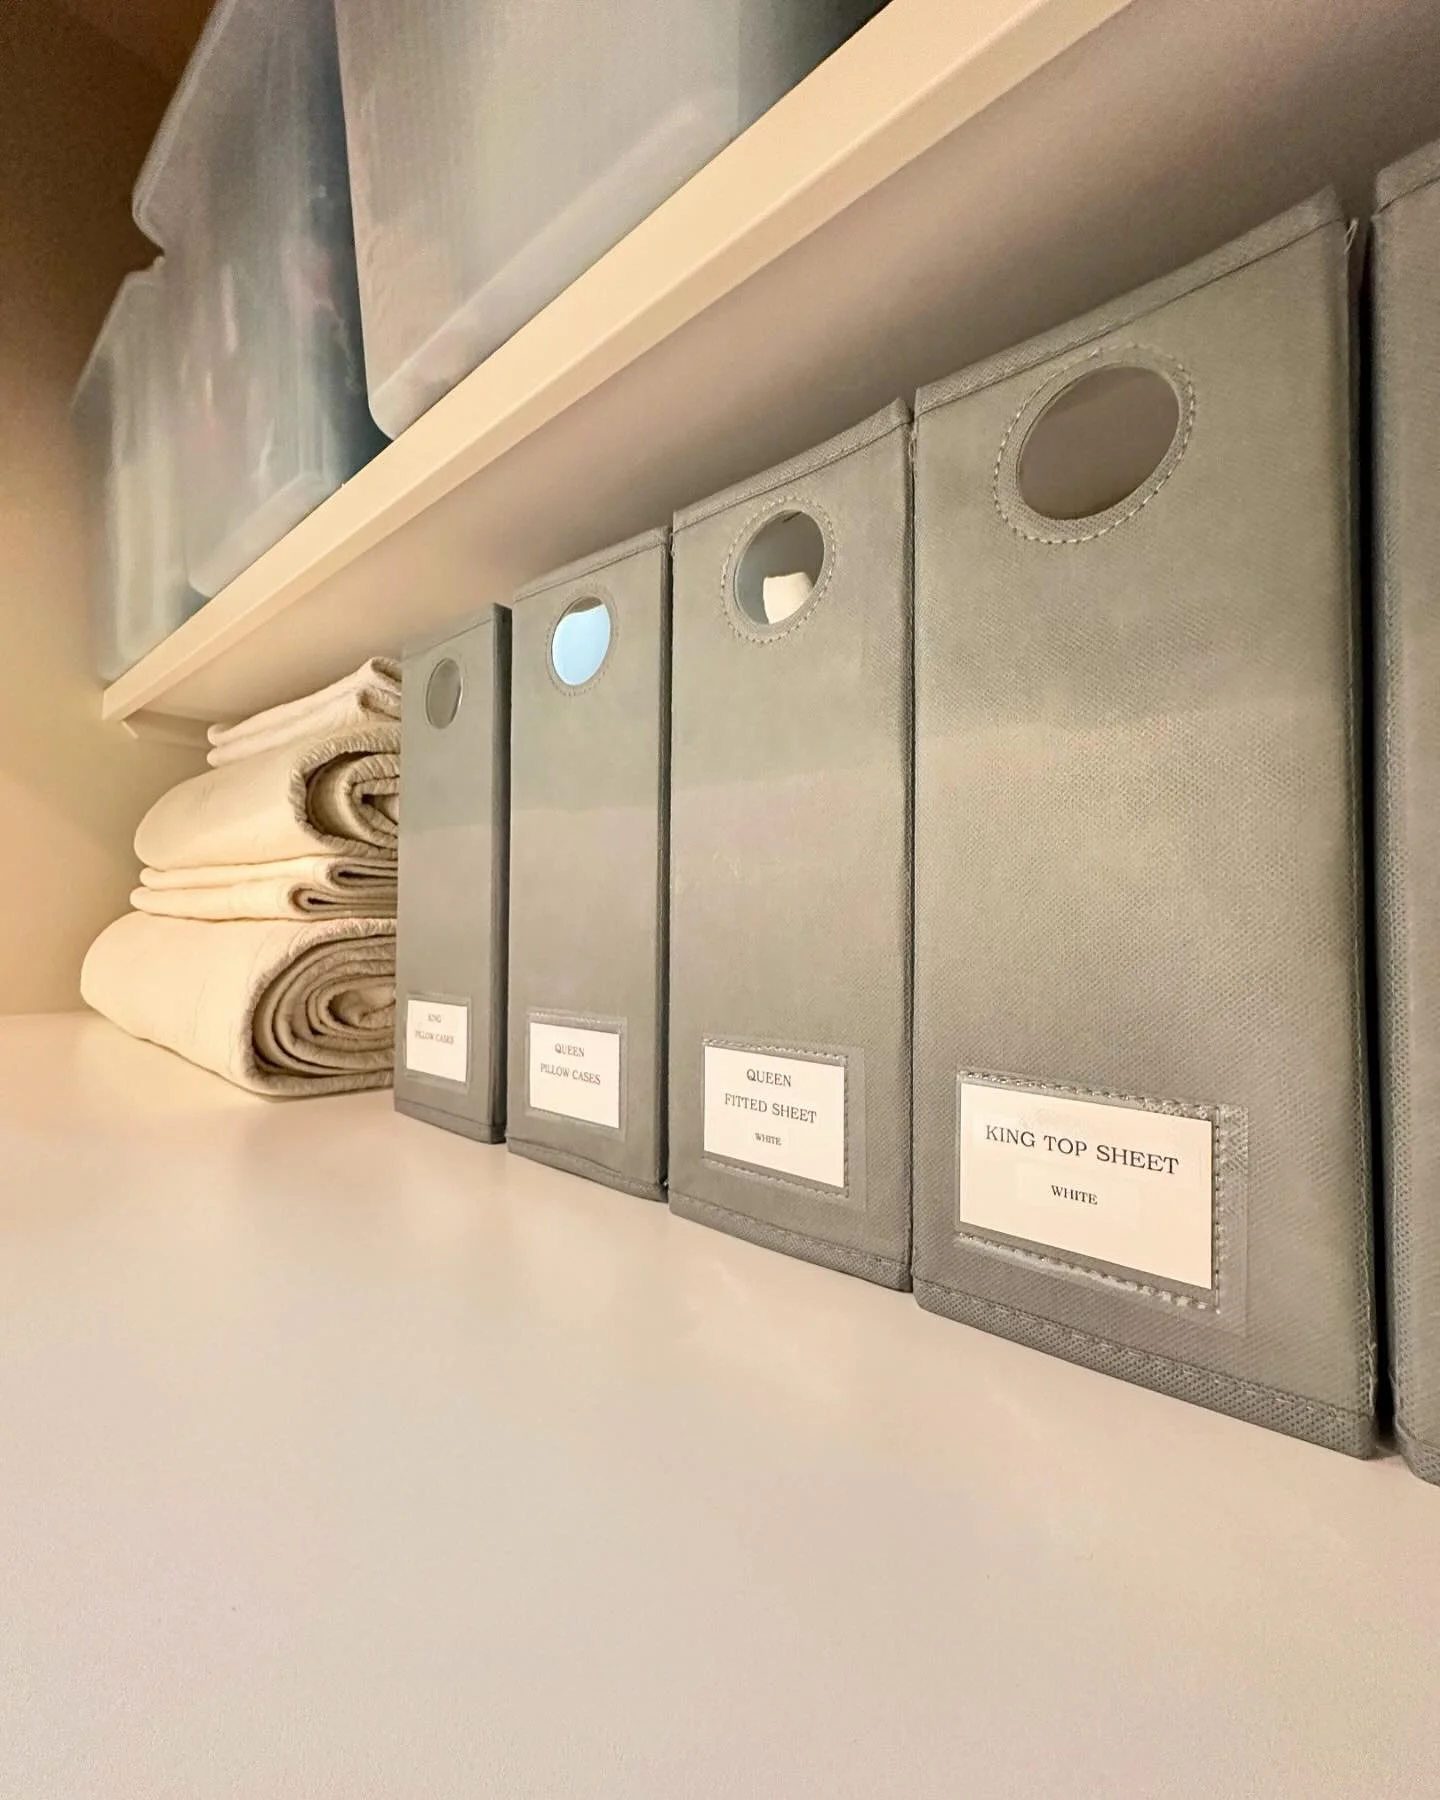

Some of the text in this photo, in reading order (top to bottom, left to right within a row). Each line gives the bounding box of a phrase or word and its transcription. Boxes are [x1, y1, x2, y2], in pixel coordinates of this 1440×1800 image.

[554, 1043, 585, 1057] QUEEN
[540, 1062, 601, 1086] PILLOW CASES
[746, 1068, 792, 1088] QUEEN
[724, 1092, 817, 1124] FITTED SHEET
[754, 1132, 782, 1147] WHITE
[986, 1124, 1180, 1175] KING TOP SHEET
[1051, 1184, 1099, 1206] WHITE
